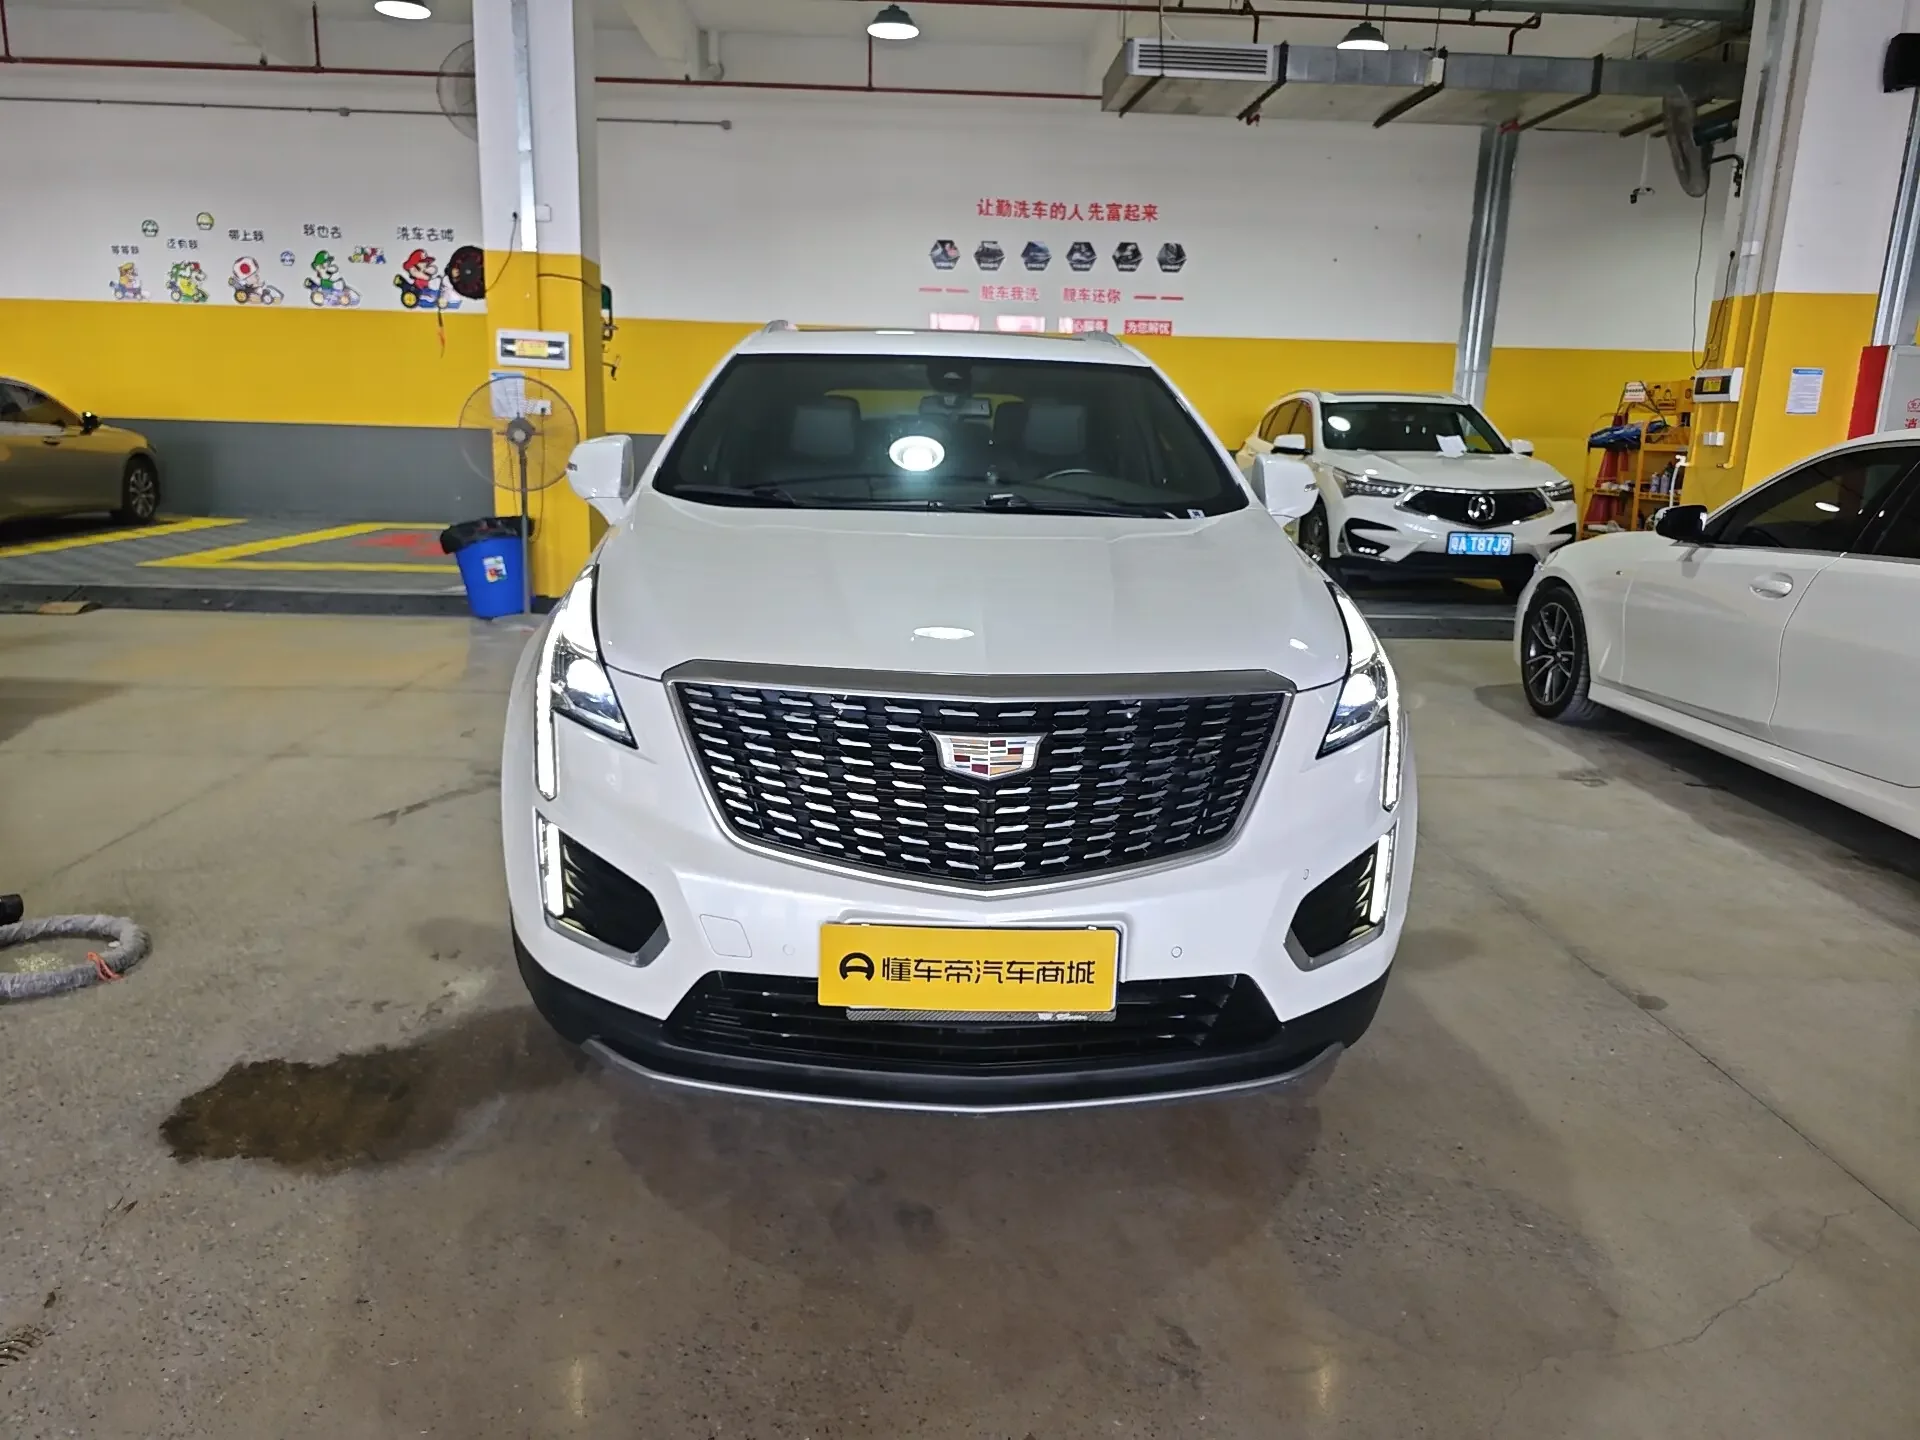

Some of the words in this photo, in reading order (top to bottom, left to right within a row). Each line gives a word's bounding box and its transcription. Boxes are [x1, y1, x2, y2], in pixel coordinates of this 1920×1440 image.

[977, 198, 1158, 222] 让勤洗车的人先富起来
[881, 956, 1096, 984] 懂车帝汽车商城
